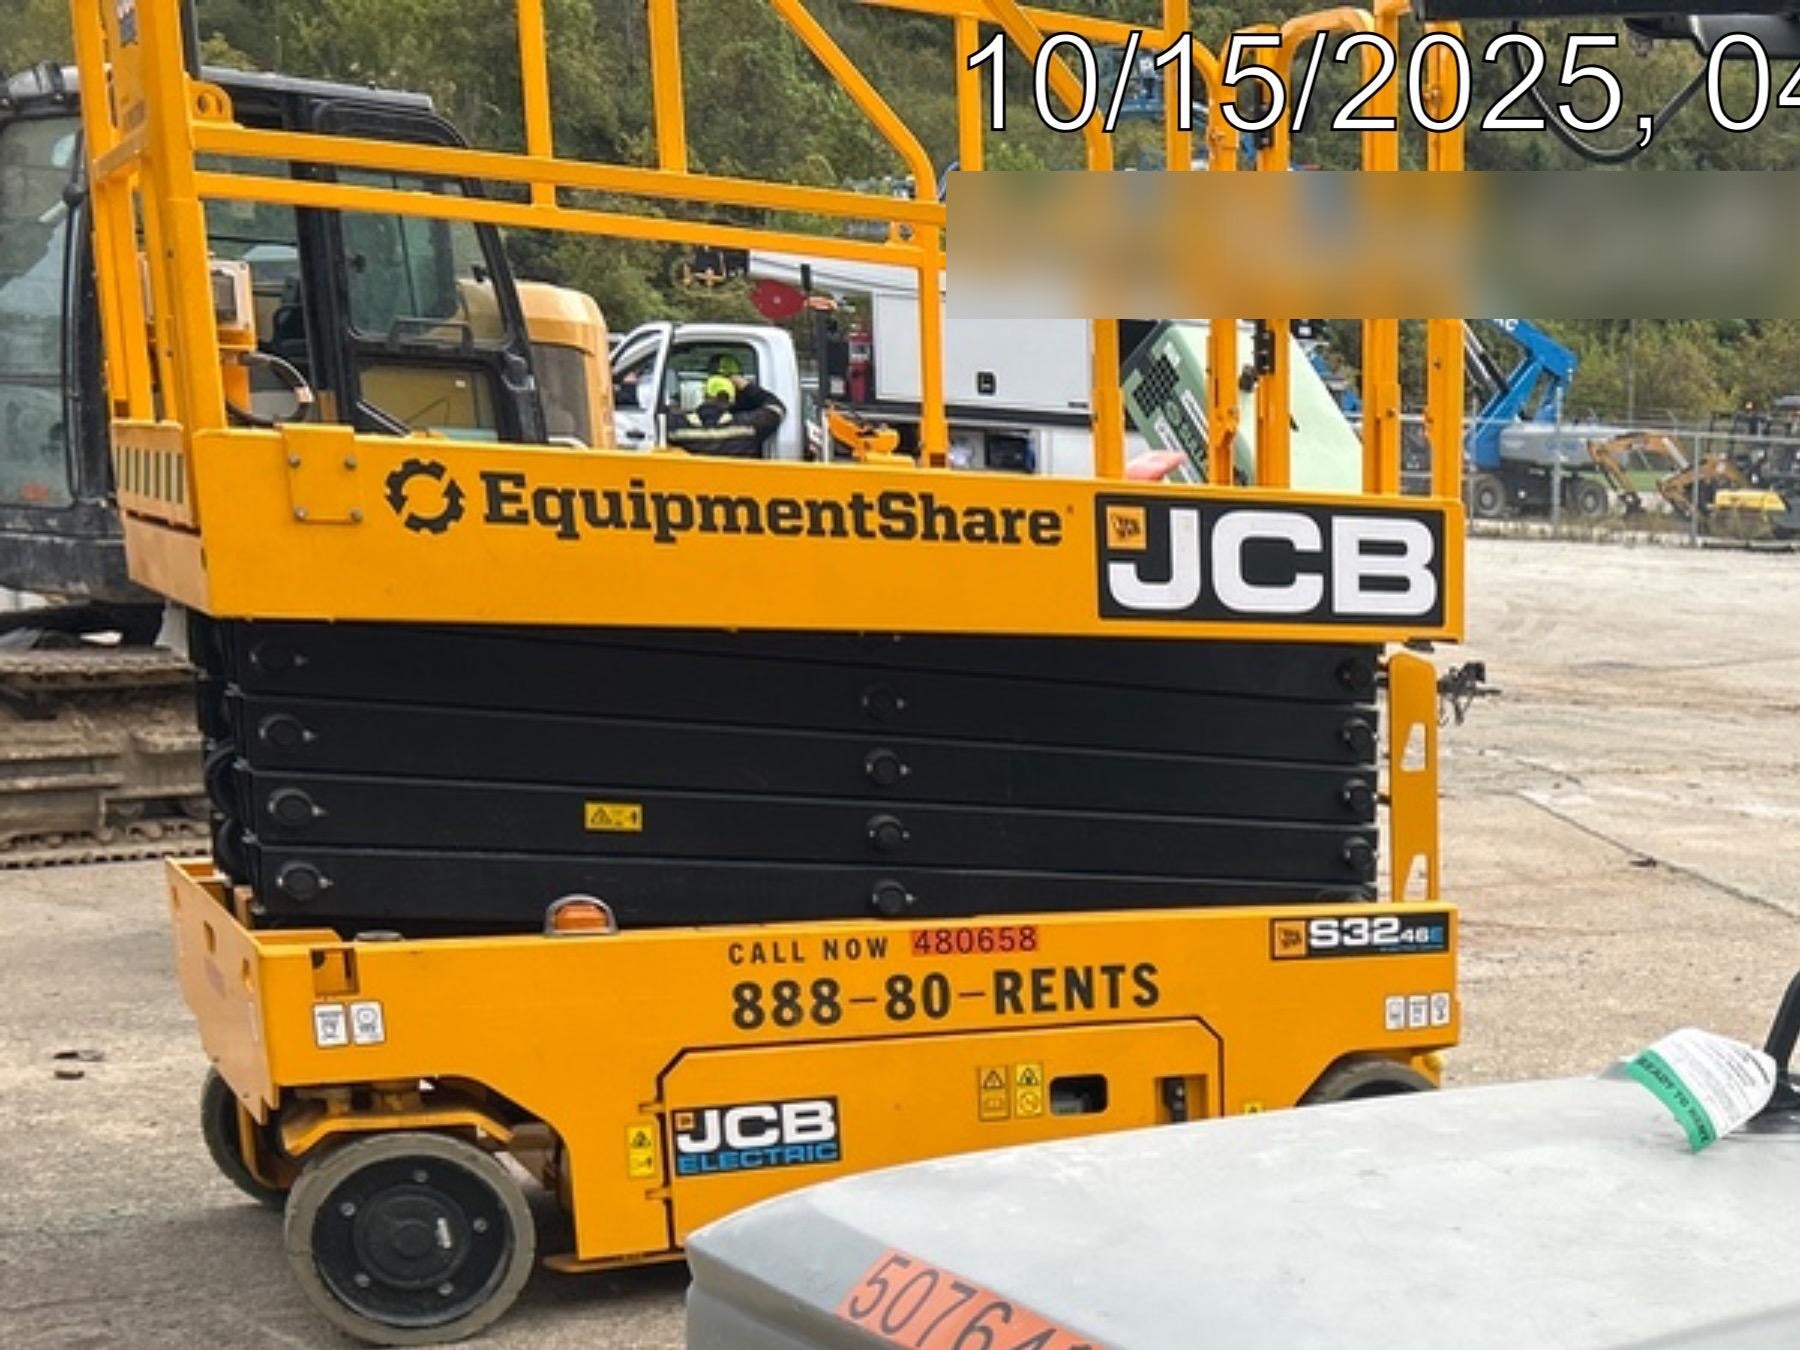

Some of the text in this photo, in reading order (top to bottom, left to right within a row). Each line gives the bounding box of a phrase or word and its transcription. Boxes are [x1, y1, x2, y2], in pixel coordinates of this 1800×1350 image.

[480, 470, 1062, 546] EquipmentShare
[1108, 507, 1437, 616] JCB
[727, 936, 890, 967] CALL NOW
[913, 927, 1038, 956] 480658
[731, 963, 1160, 1031] 888-80-RENTS
[676, 1101, 838, 1154] JCB
[677, 1142, 838, 1175] ELECTRIC
